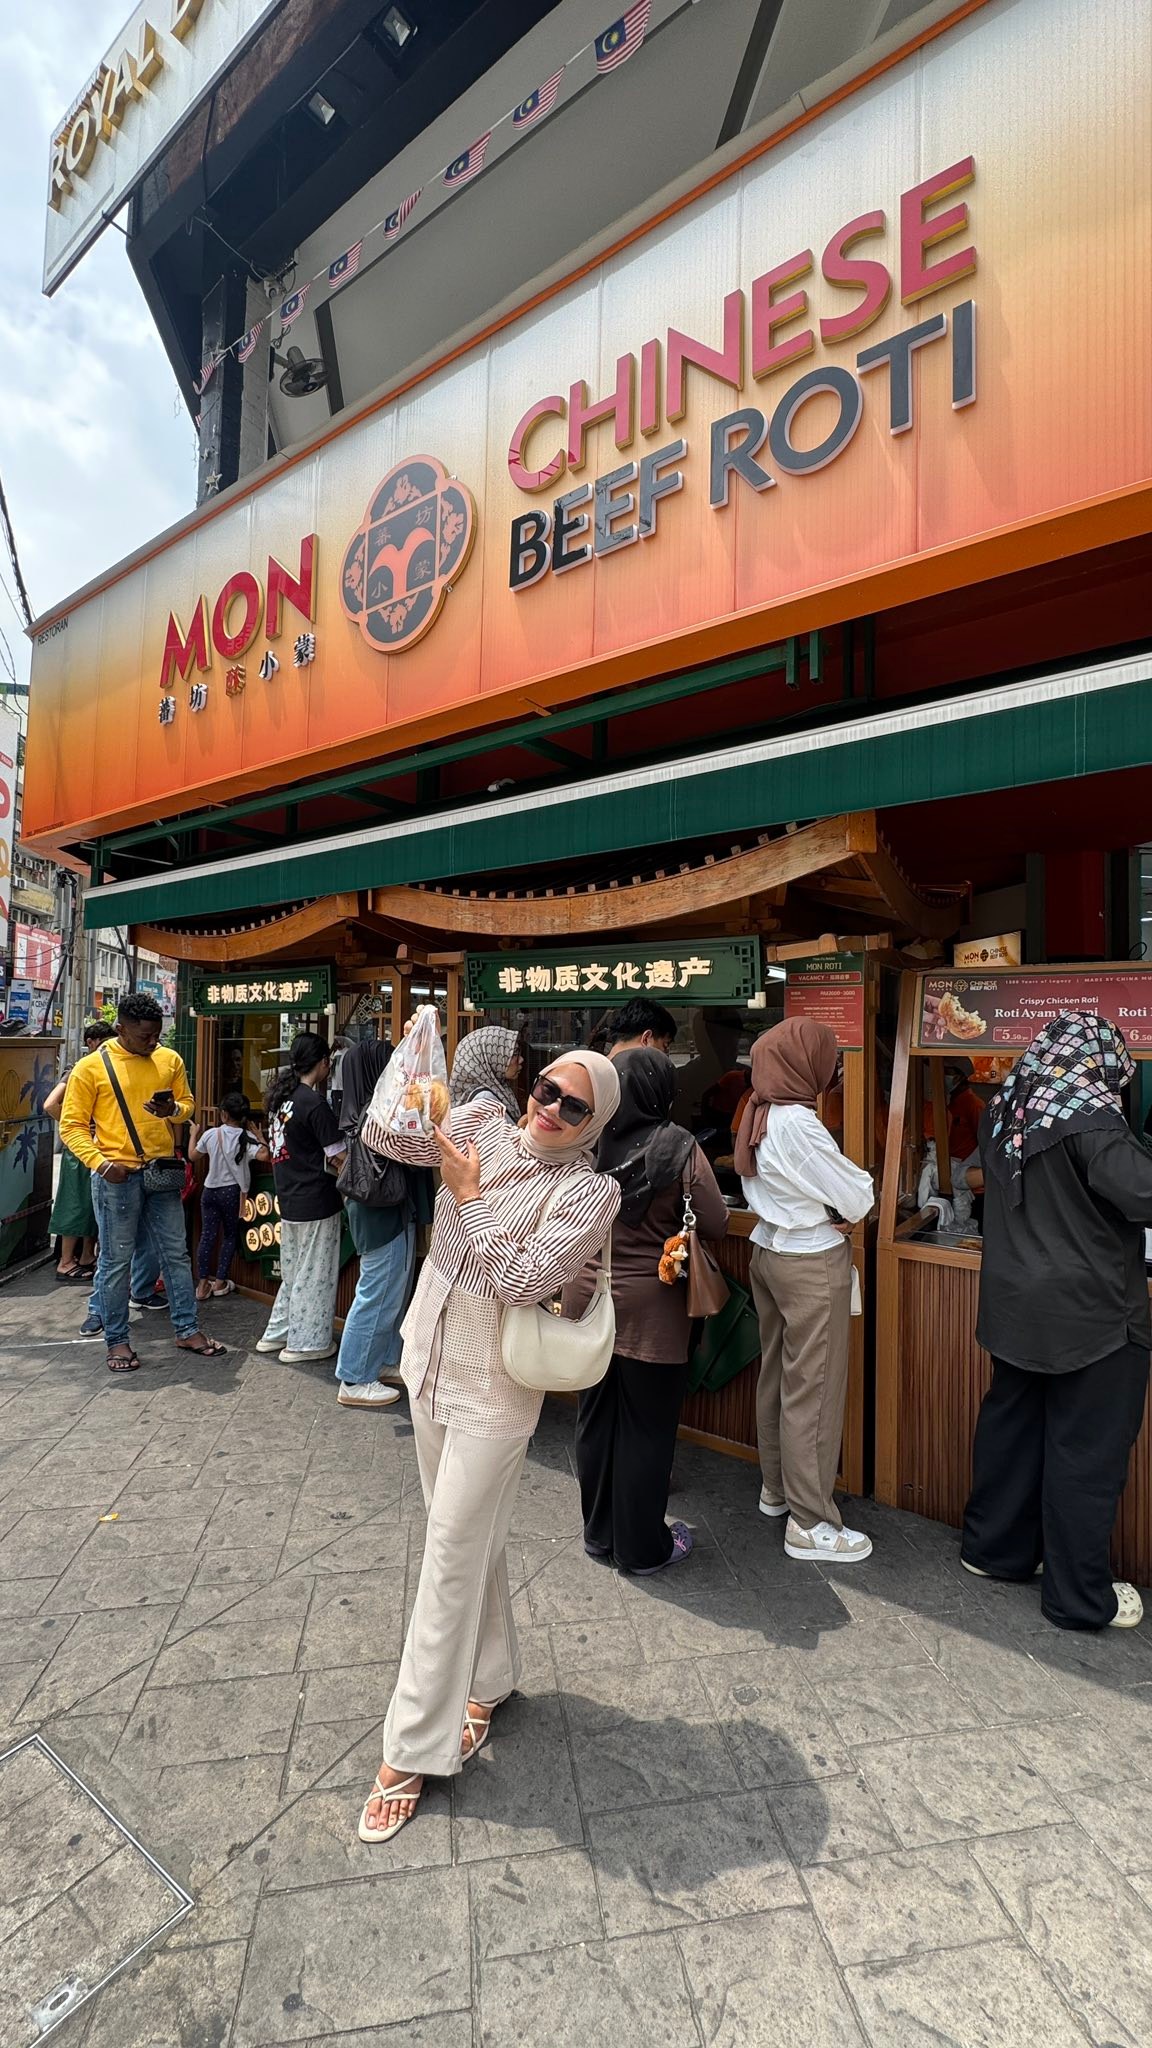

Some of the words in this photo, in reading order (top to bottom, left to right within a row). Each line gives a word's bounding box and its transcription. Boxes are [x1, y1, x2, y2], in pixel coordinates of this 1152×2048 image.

[48, 19, 163, 212] ROYAL
[508, 155, 977, 494] CHINESE
[509, 439, 688, 592] BEEF
[710, 300, 977, 510] ROTI
[160, 533, 320, 690] MON
[38, 616, 69, 647] RESTORAN
[824, 962, 842, 970] ROTI
[964, 951, 980, 961] MON
[498, 957, 713, 994] 非物质文化遗产
[928, 980, 953, 988] MON
[207, 980, 311, 1004] 非物质文化遗产
[1019, 997, 1045, 1006] Crispy
[995, 1008, 1019, 1018] Roti
[1022, 1008, 1056, 1019] Ayam
[1118, 1006, 1147, 1017] Roti
